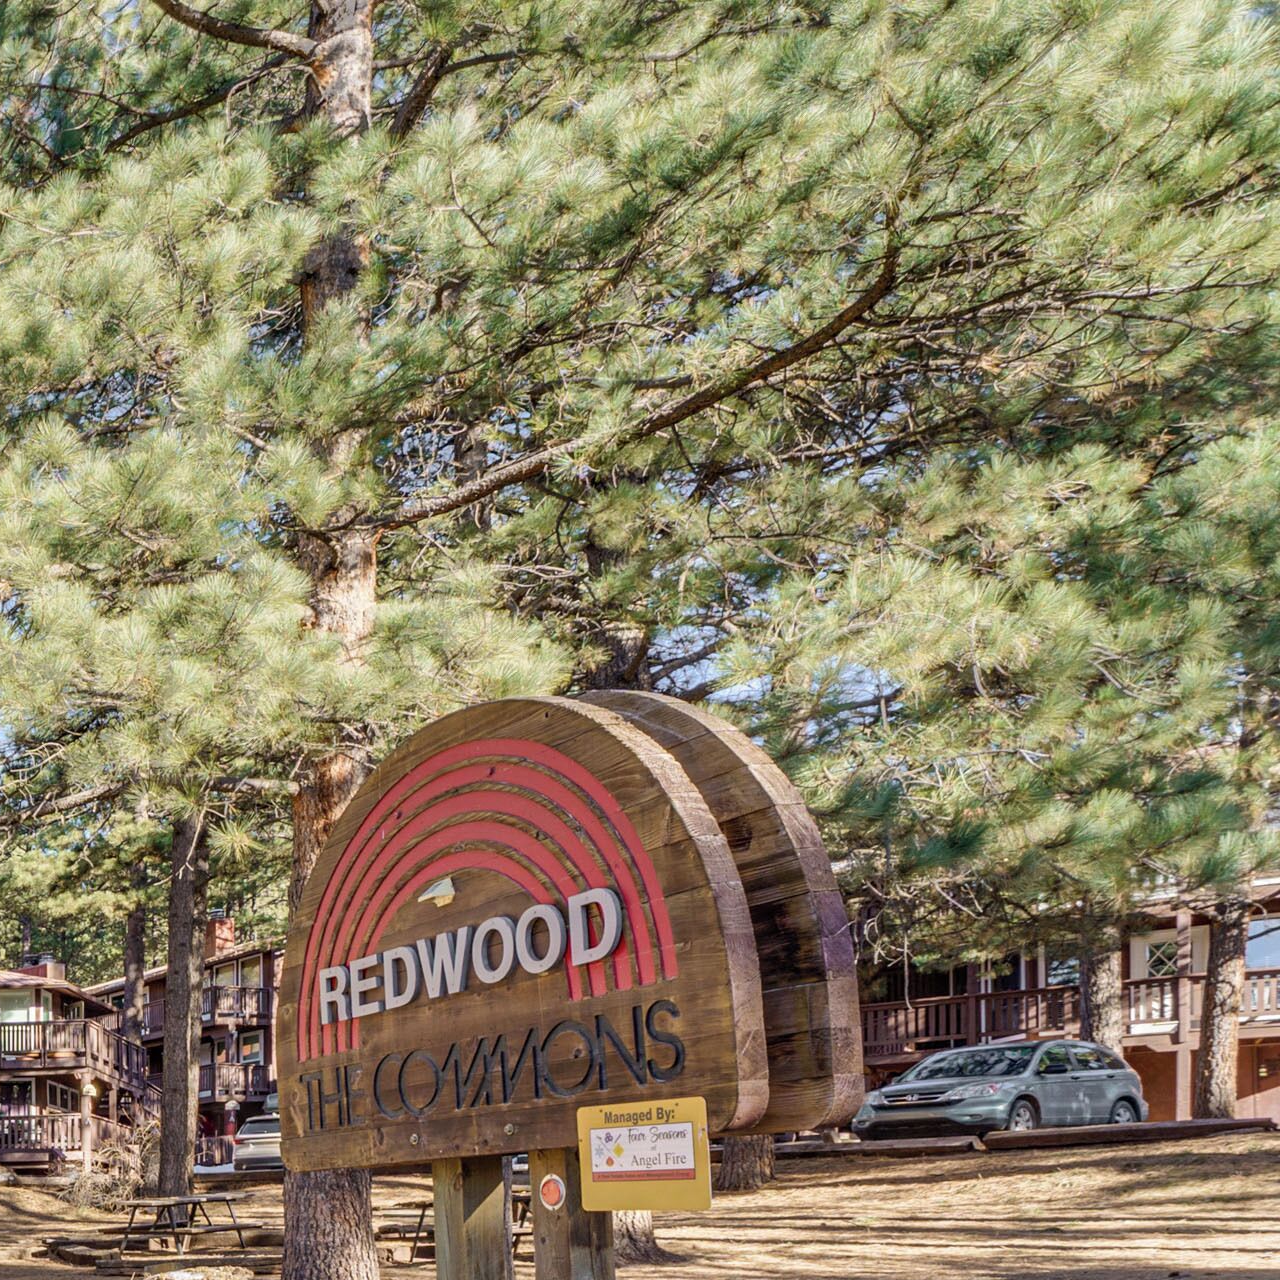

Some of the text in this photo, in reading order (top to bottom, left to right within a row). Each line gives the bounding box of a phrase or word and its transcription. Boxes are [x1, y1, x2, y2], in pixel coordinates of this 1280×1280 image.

[319, 888, 622, 1024] REDWOOD
[299, 1000, 685, 1129] THE COMMONS
[604, 1107, 675, 1125] Managed By:
[627, 1126, 688, 1144] Four Seasons
[631, 1152, 686, 1168] Angel Fire
